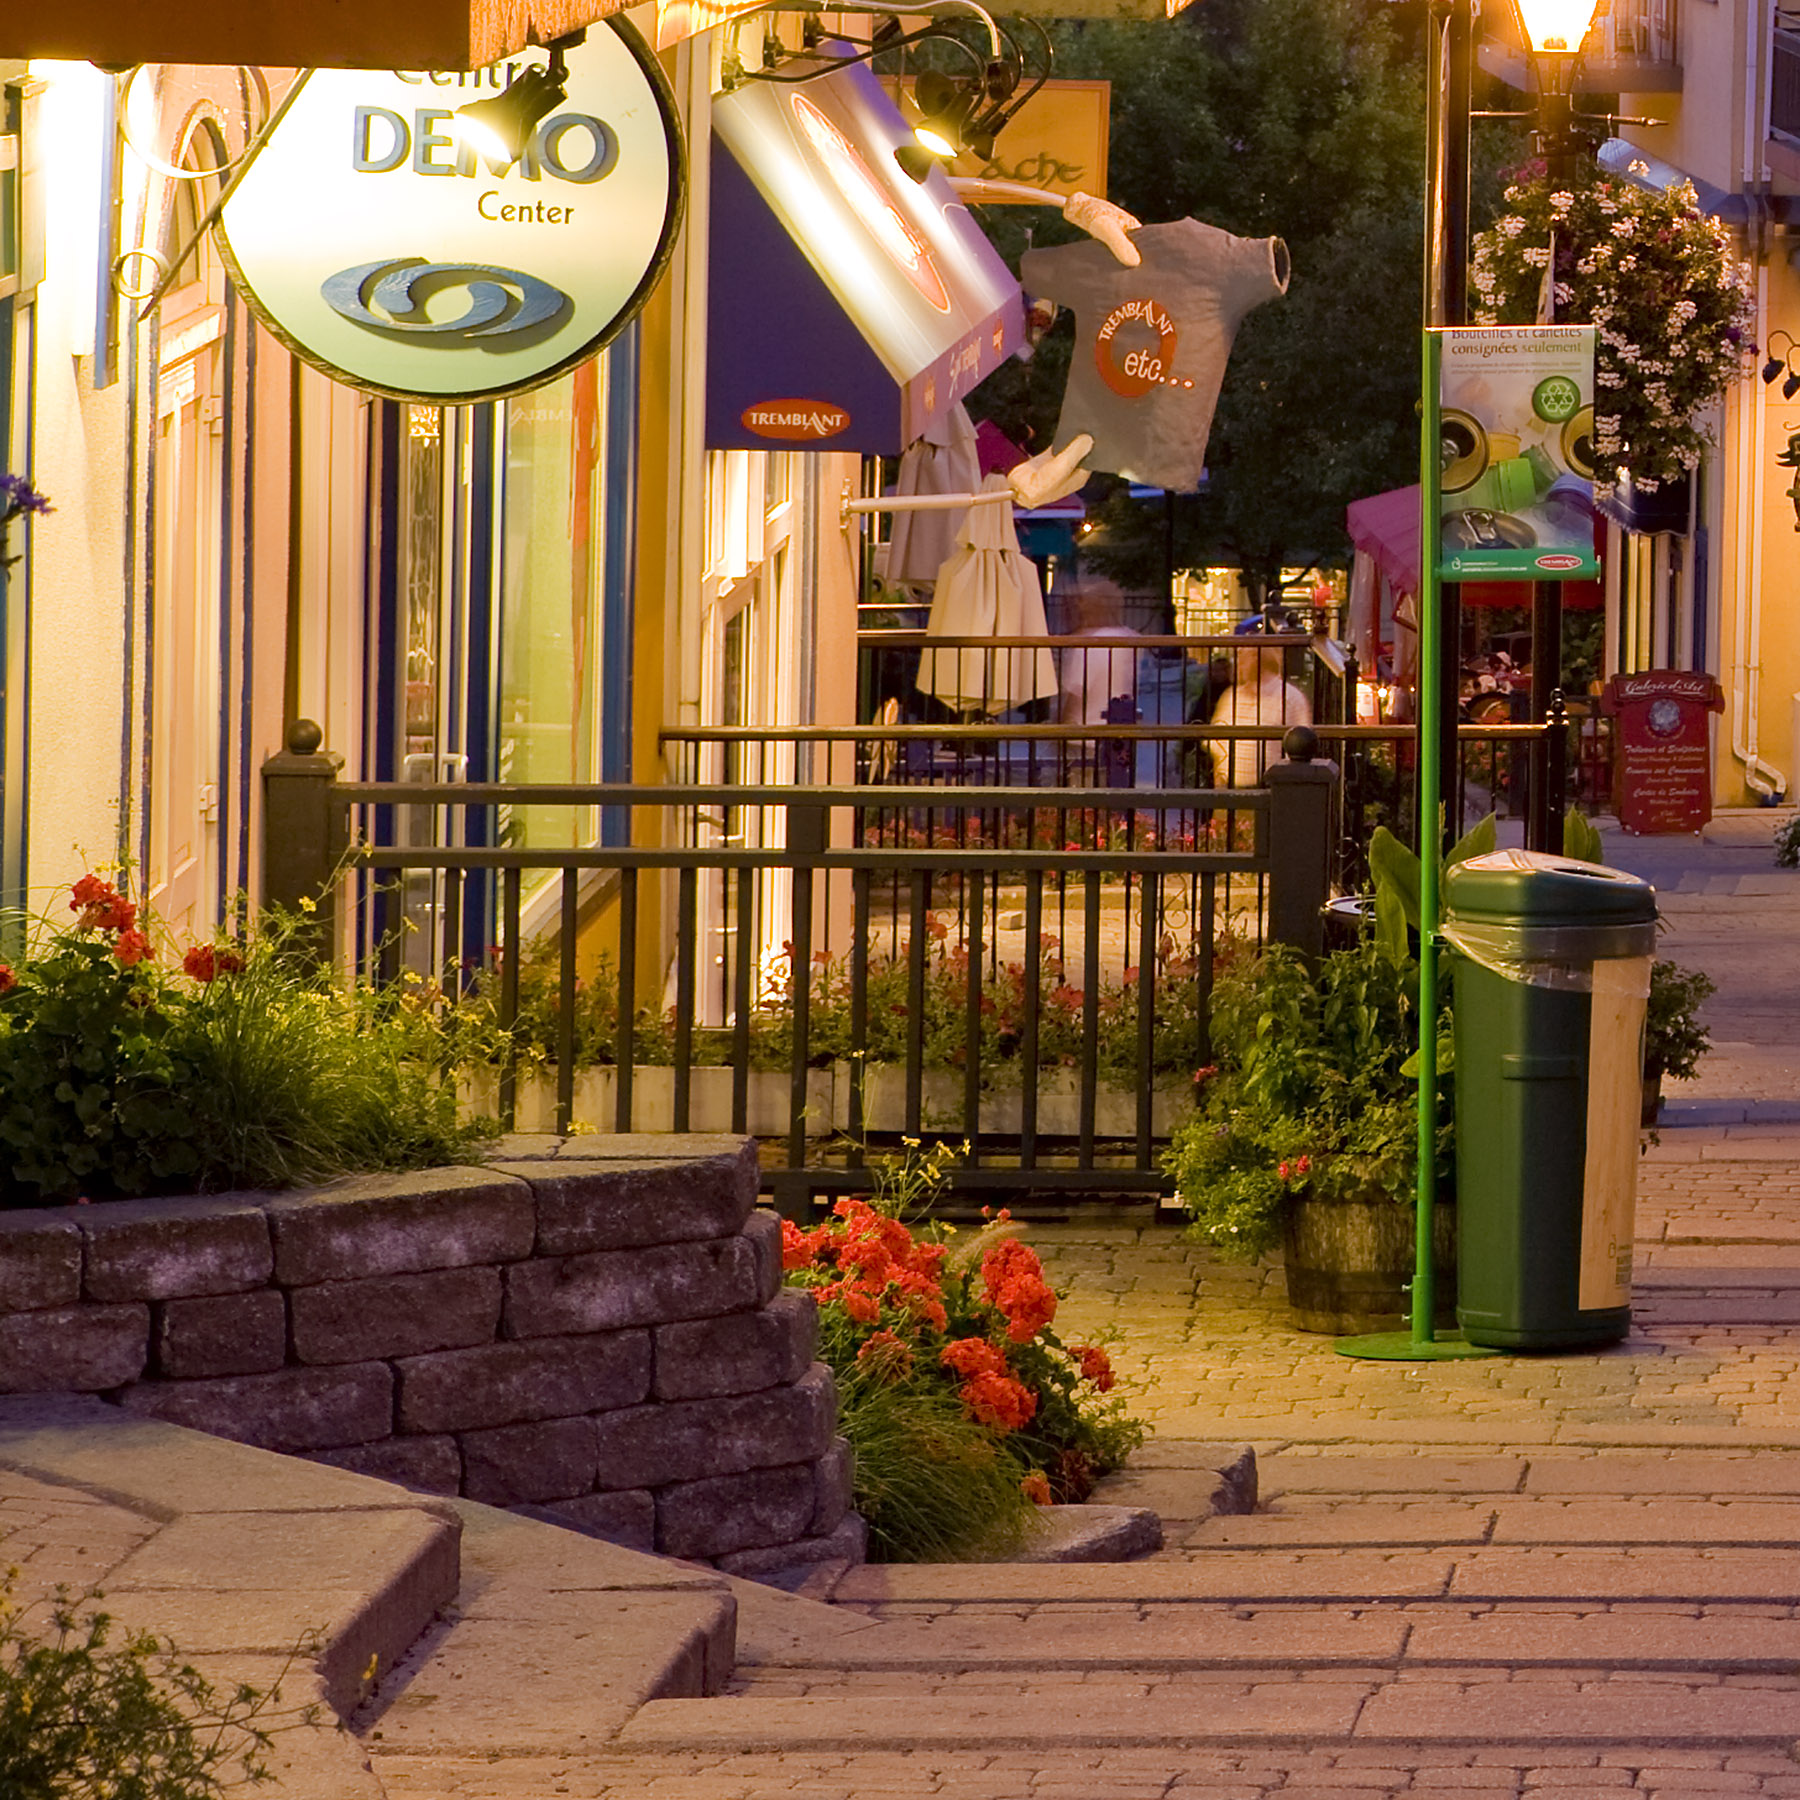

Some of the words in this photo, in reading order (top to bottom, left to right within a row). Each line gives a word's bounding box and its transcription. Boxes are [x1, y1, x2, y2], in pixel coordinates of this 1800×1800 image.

[477, 191, 575, 224] Center
[1097, 300, 1174, 341] TREMBLANT
[1451, 341, 1518, 358] consignées
[1522, 340, 1582, 354] seulement
[749, 411, 845, 436] TREMBLANT
